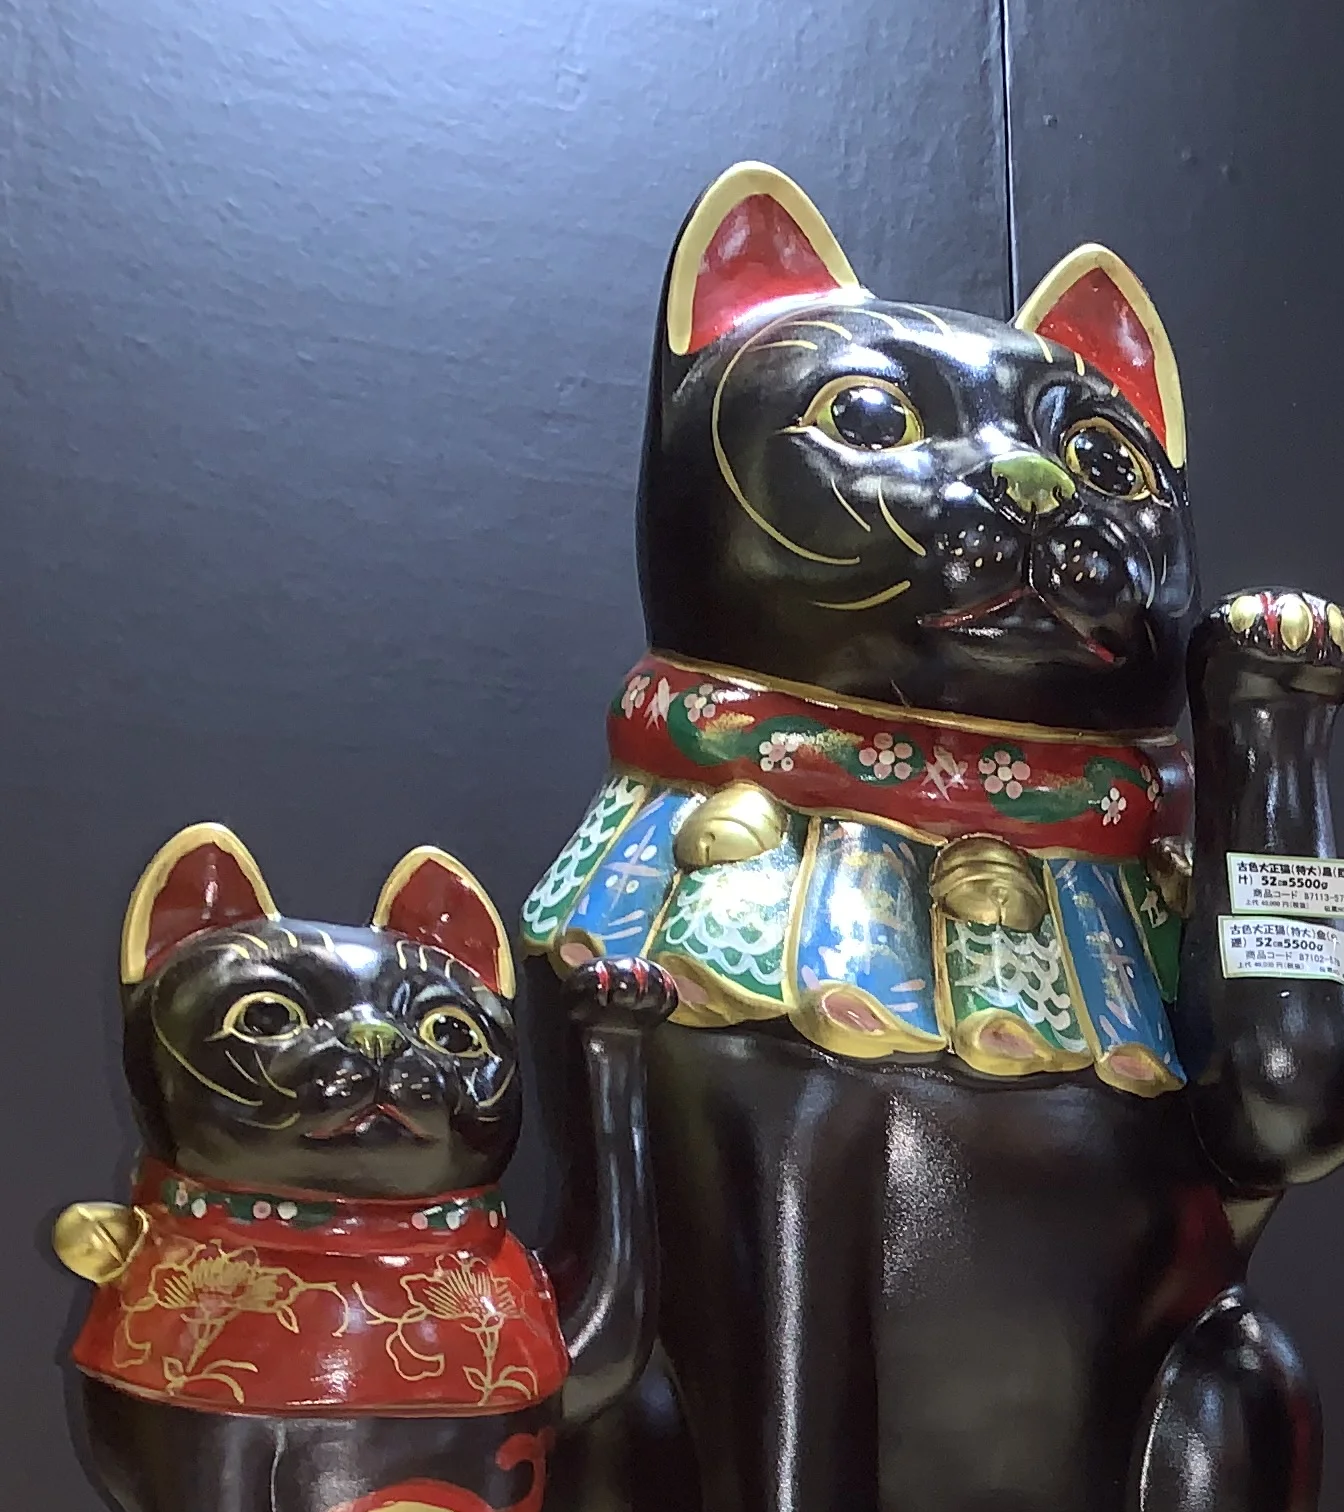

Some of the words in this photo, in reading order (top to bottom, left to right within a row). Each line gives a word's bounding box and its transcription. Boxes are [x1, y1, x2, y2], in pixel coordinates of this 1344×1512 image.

[1253, 888, 1298, 899] 商品コード
[1245, 950, 1292, 960] 商品コード
